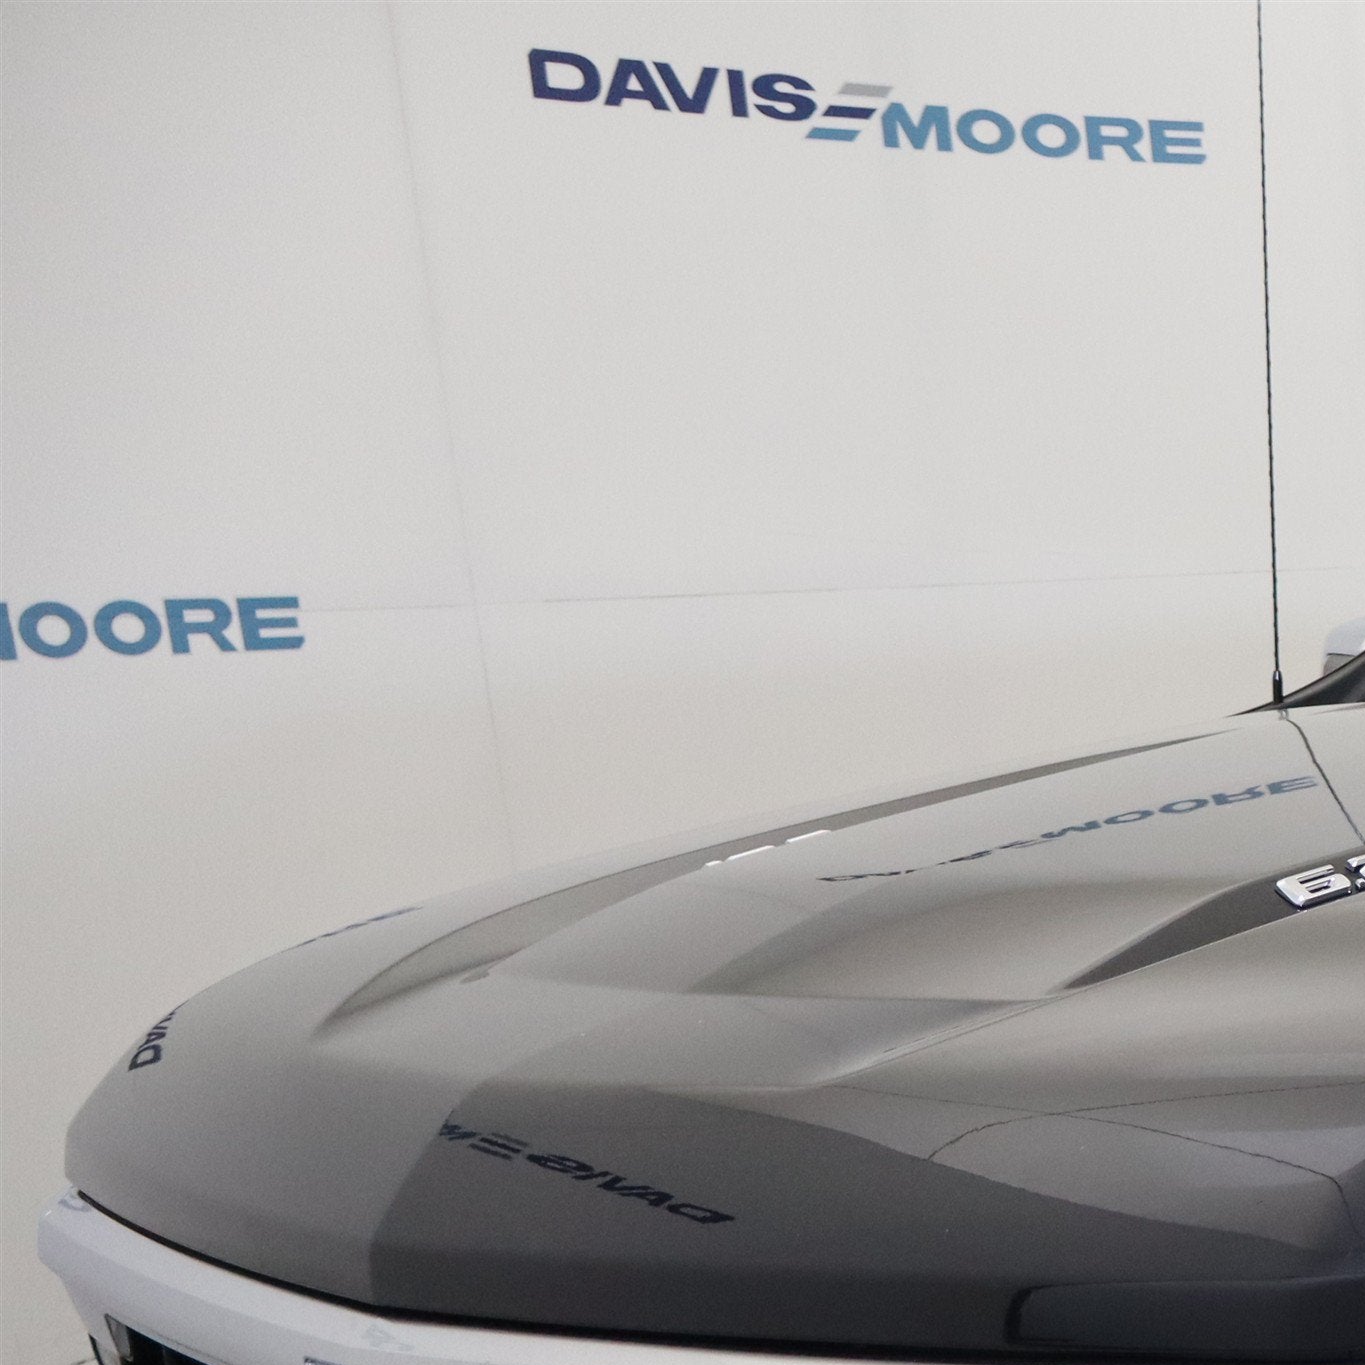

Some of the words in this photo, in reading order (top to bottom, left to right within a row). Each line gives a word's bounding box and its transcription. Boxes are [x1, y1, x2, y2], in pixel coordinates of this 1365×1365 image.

[527, 48, 818, 121] DAVIS
[880, 102, 1208, 165] MOORE
[0, 596, 305, 661] OORE
